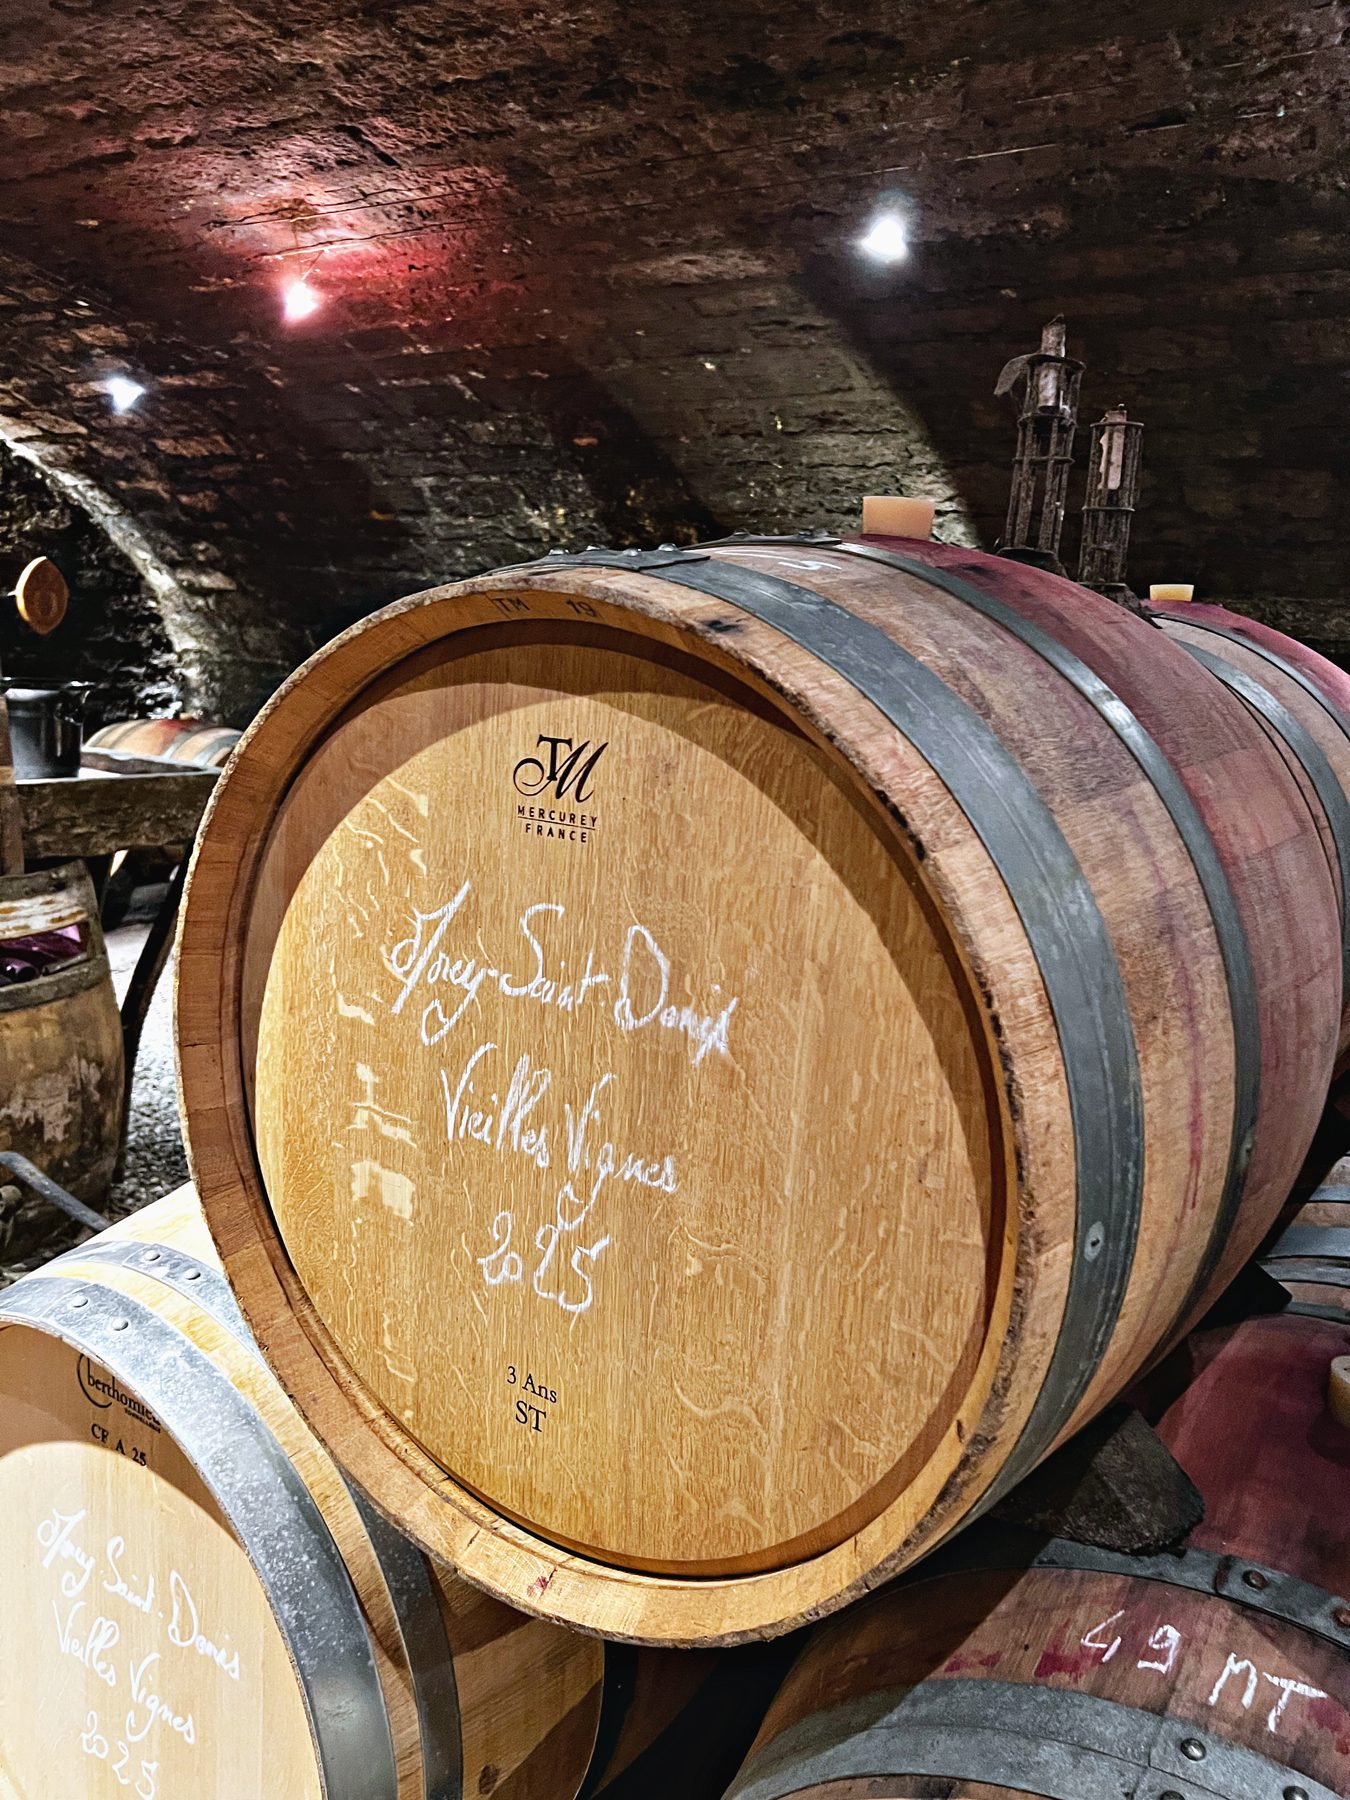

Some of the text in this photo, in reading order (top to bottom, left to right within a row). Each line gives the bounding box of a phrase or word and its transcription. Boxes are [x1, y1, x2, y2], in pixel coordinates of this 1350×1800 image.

[517, 804, 598, 828] MERCUREY
[525, 822, 588, 843] FRANCE
[506, 1365, 557, 1404] 3 Ans
[515, 1400, 547, 1433] ST
[131, 1446, 147, 1467] 25
